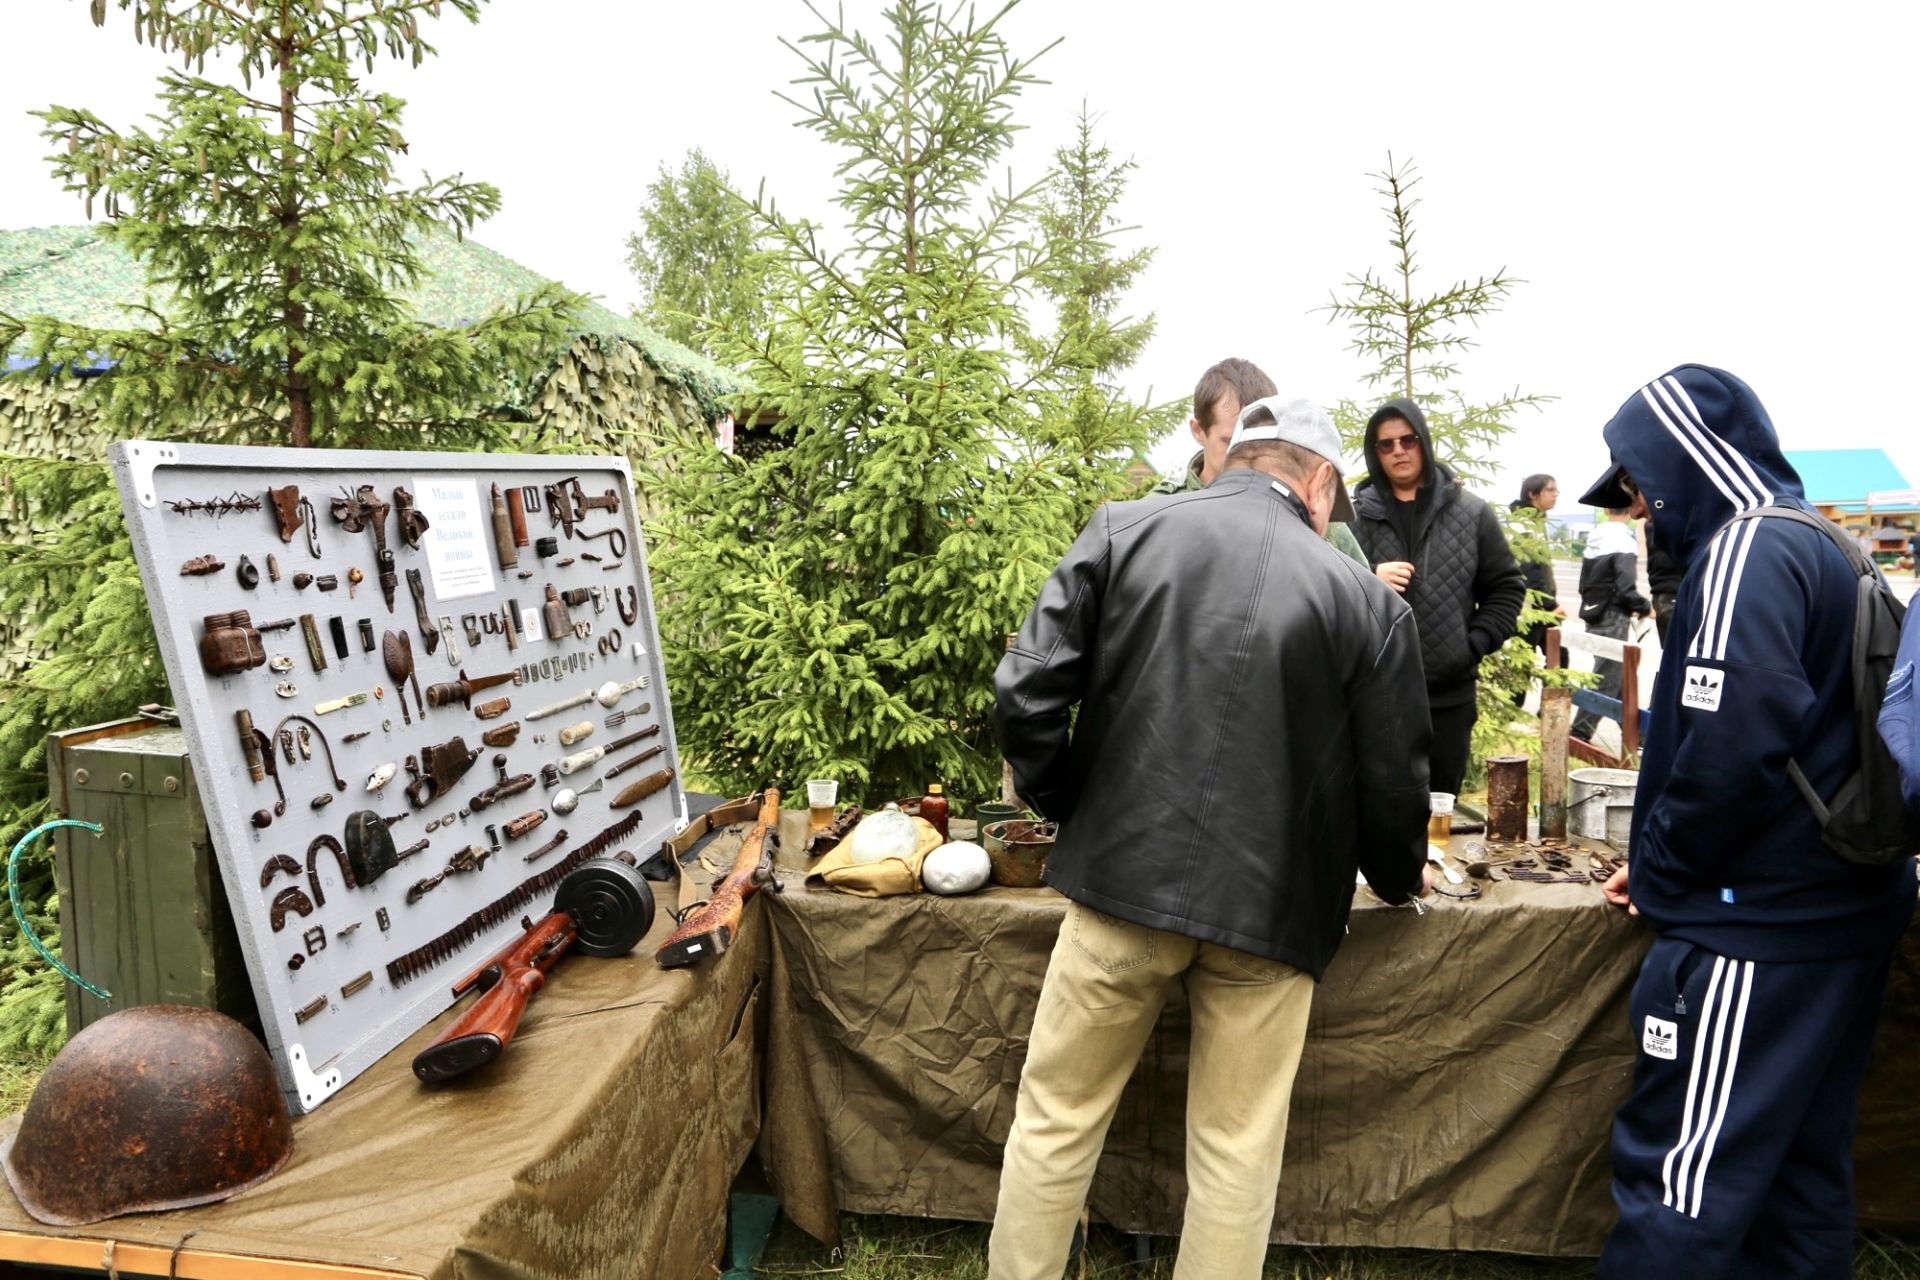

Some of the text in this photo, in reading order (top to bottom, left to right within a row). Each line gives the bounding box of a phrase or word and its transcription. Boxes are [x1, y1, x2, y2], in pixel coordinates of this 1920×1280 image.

[431, 487, 464, 501] Малые
[436, 528, 474, 541] Великой
[445, 549, 473, 561] войны
[1686, 694, 1716, 706] adidas
[1645, 1042, 1673, 1055] adidas
